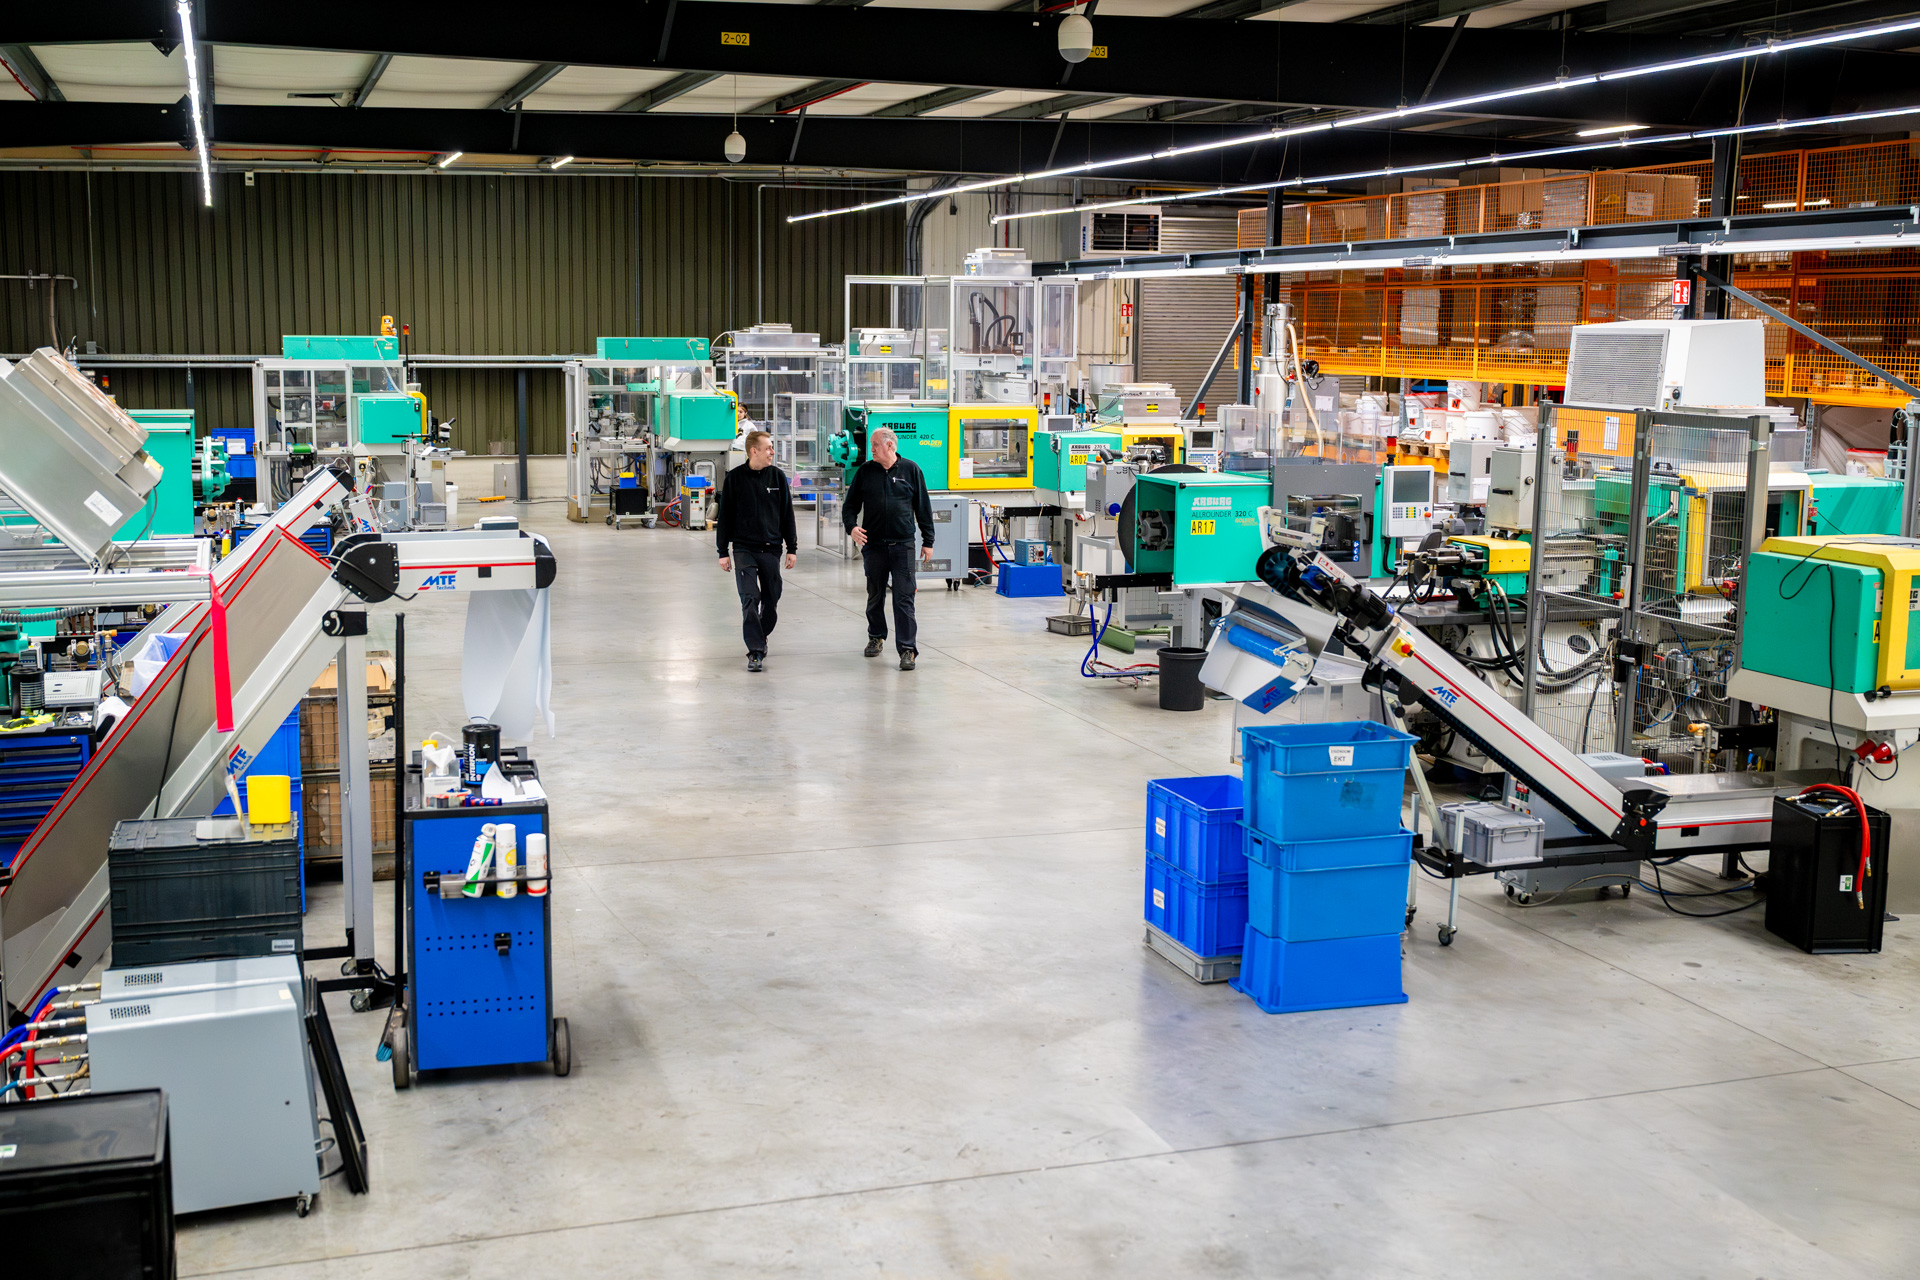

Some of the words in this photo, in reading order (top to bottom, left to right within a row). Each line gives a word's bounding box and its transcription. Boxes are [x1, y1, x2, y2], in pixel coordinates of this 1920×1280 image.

[723, 33, 748, 45] 2-02
[1091, 46, 1106, 57] -03
[881, 422, 917, 430] ARBURG
[1070, 455, 1087, 464] AR02
[1192, 497, 1232, 506] ARBURG
[1234, 510, 1247, 518] 320
[1191, 521, 1214, 534] AR17
[421, 574, 456, 586] MTF
[1432, 686, 1457, 703] MTF
[226, 748, 247, 775] MTF
[468, 743, 476, 782] INTERFLON
